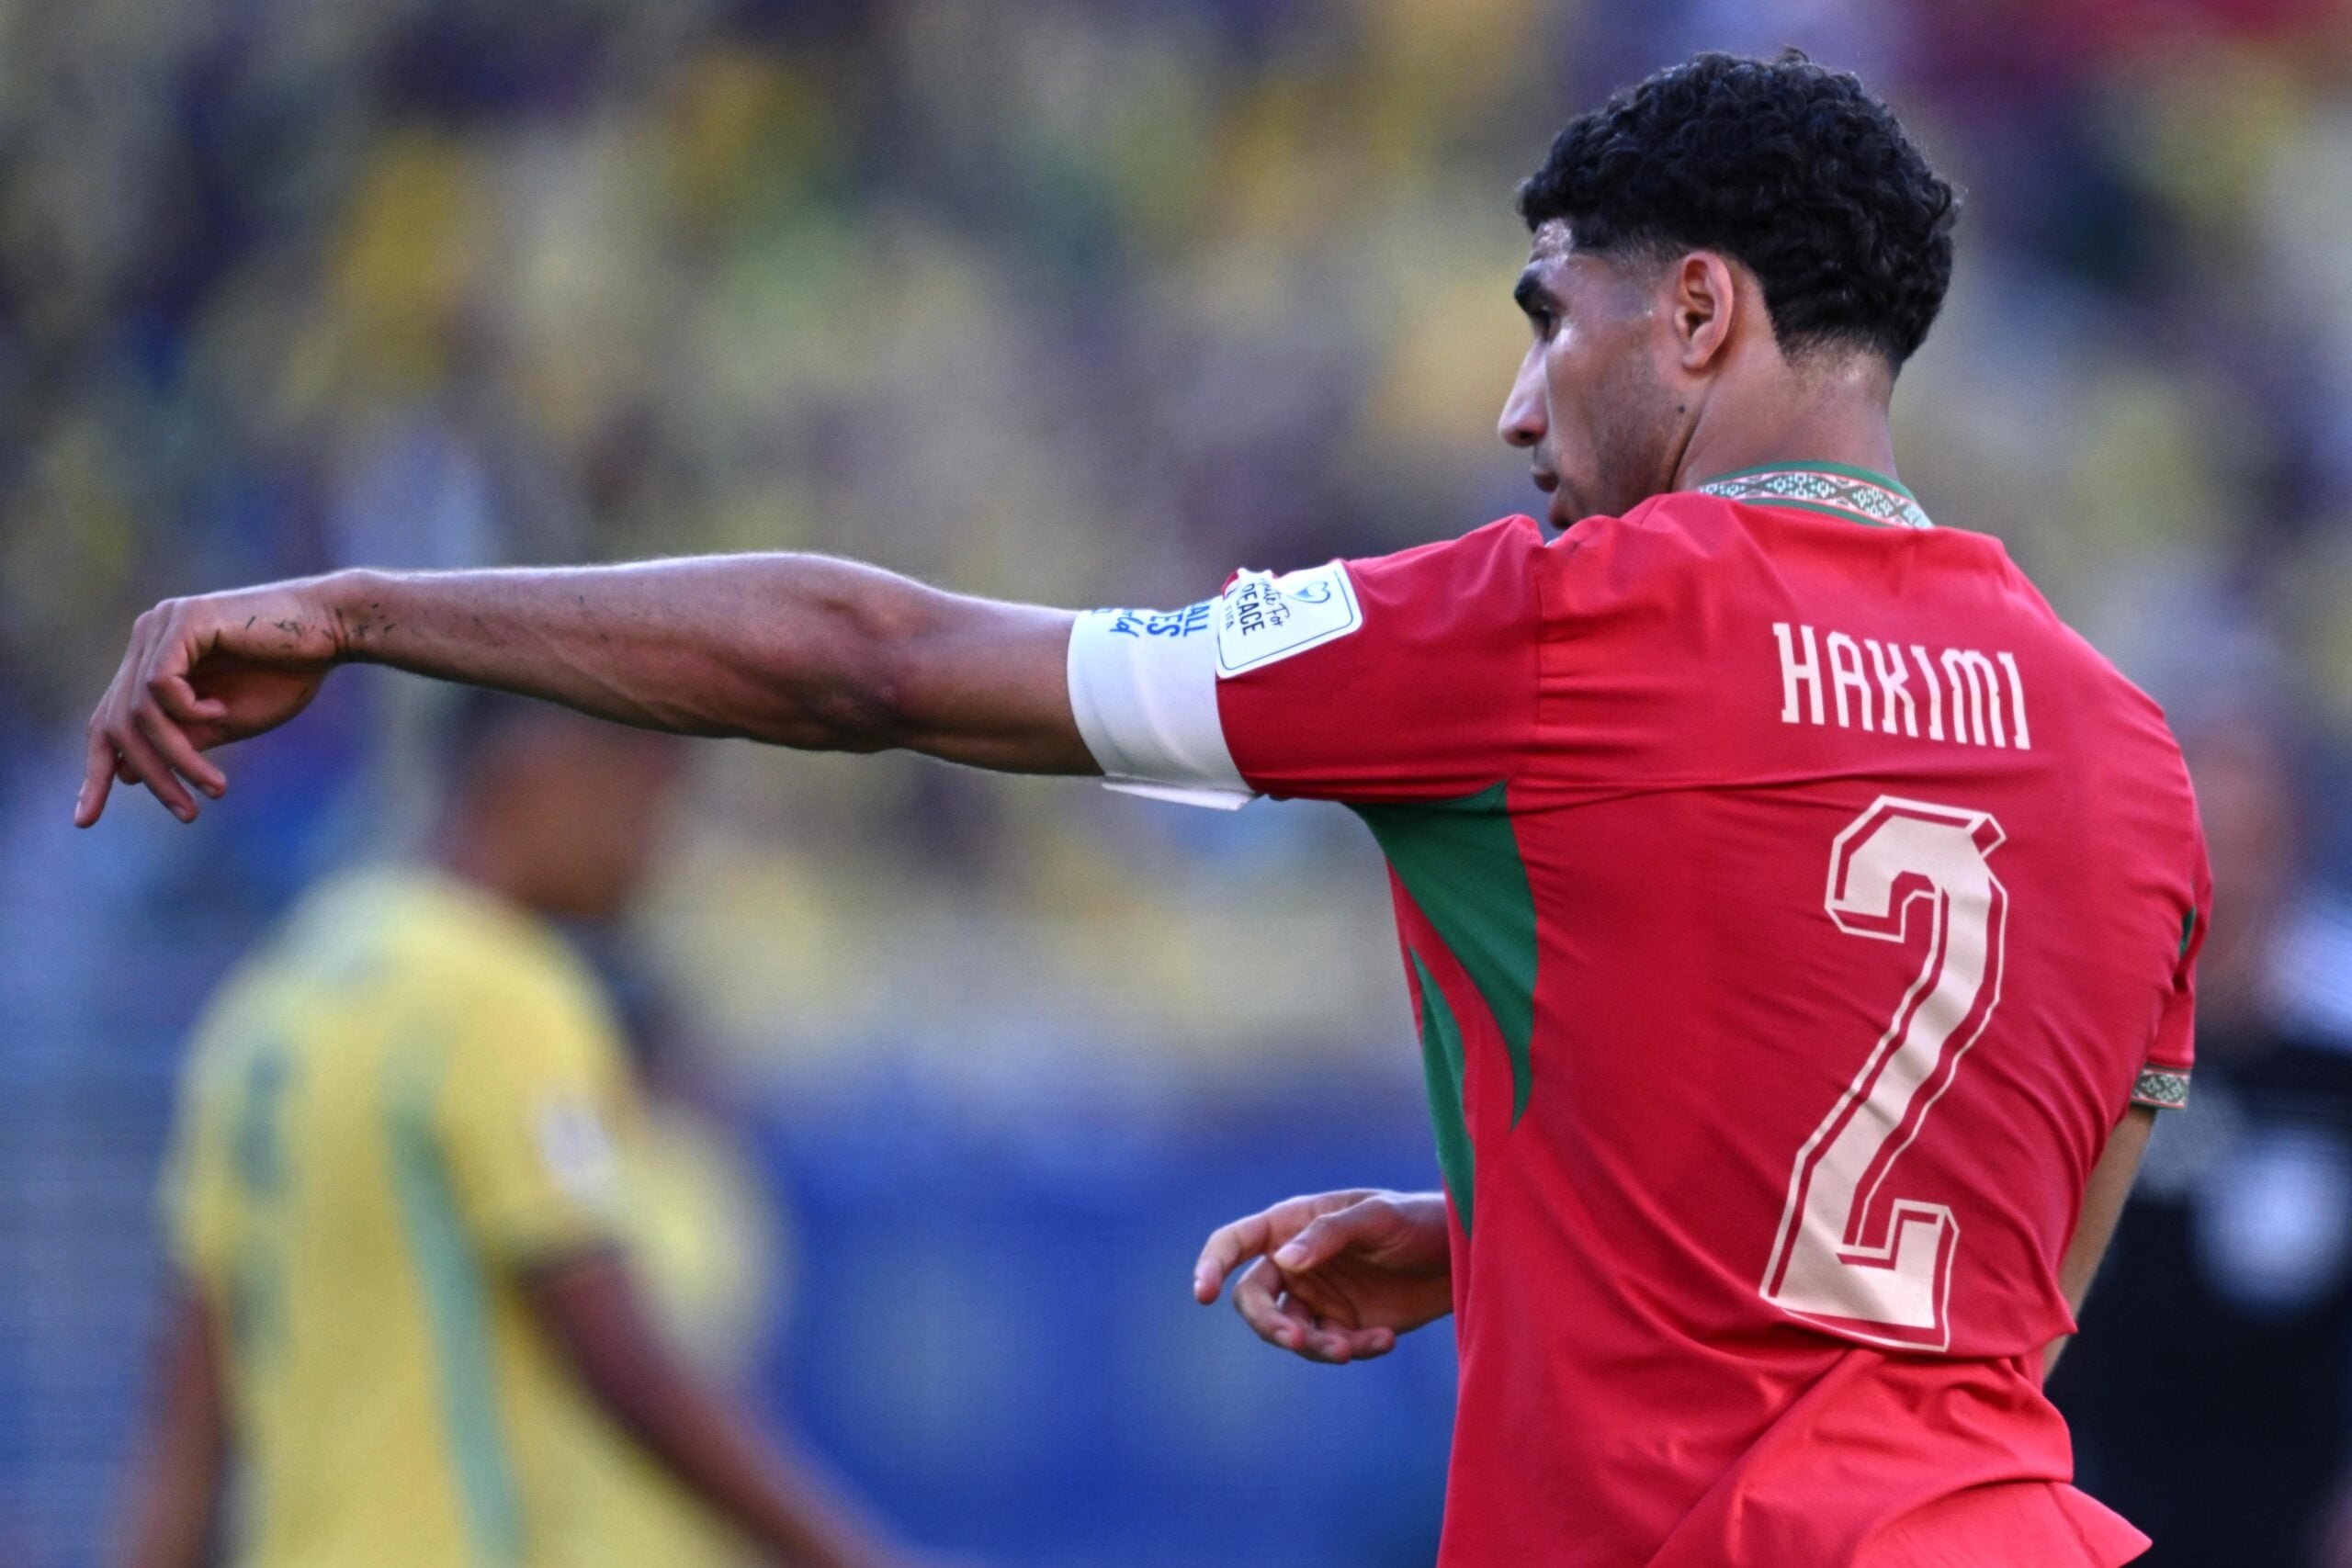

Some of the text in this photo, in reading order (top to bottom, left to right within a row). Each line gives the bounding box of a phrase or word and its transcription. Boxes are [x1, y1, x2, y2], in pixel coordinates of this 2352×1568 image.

[1237, 582, 1265, 636] PEACE
[1265, 603, 1290, 626] For
[1772, 622, 2031, 750] HAKIMI
[1758, 795, 2007, 1352] 2
